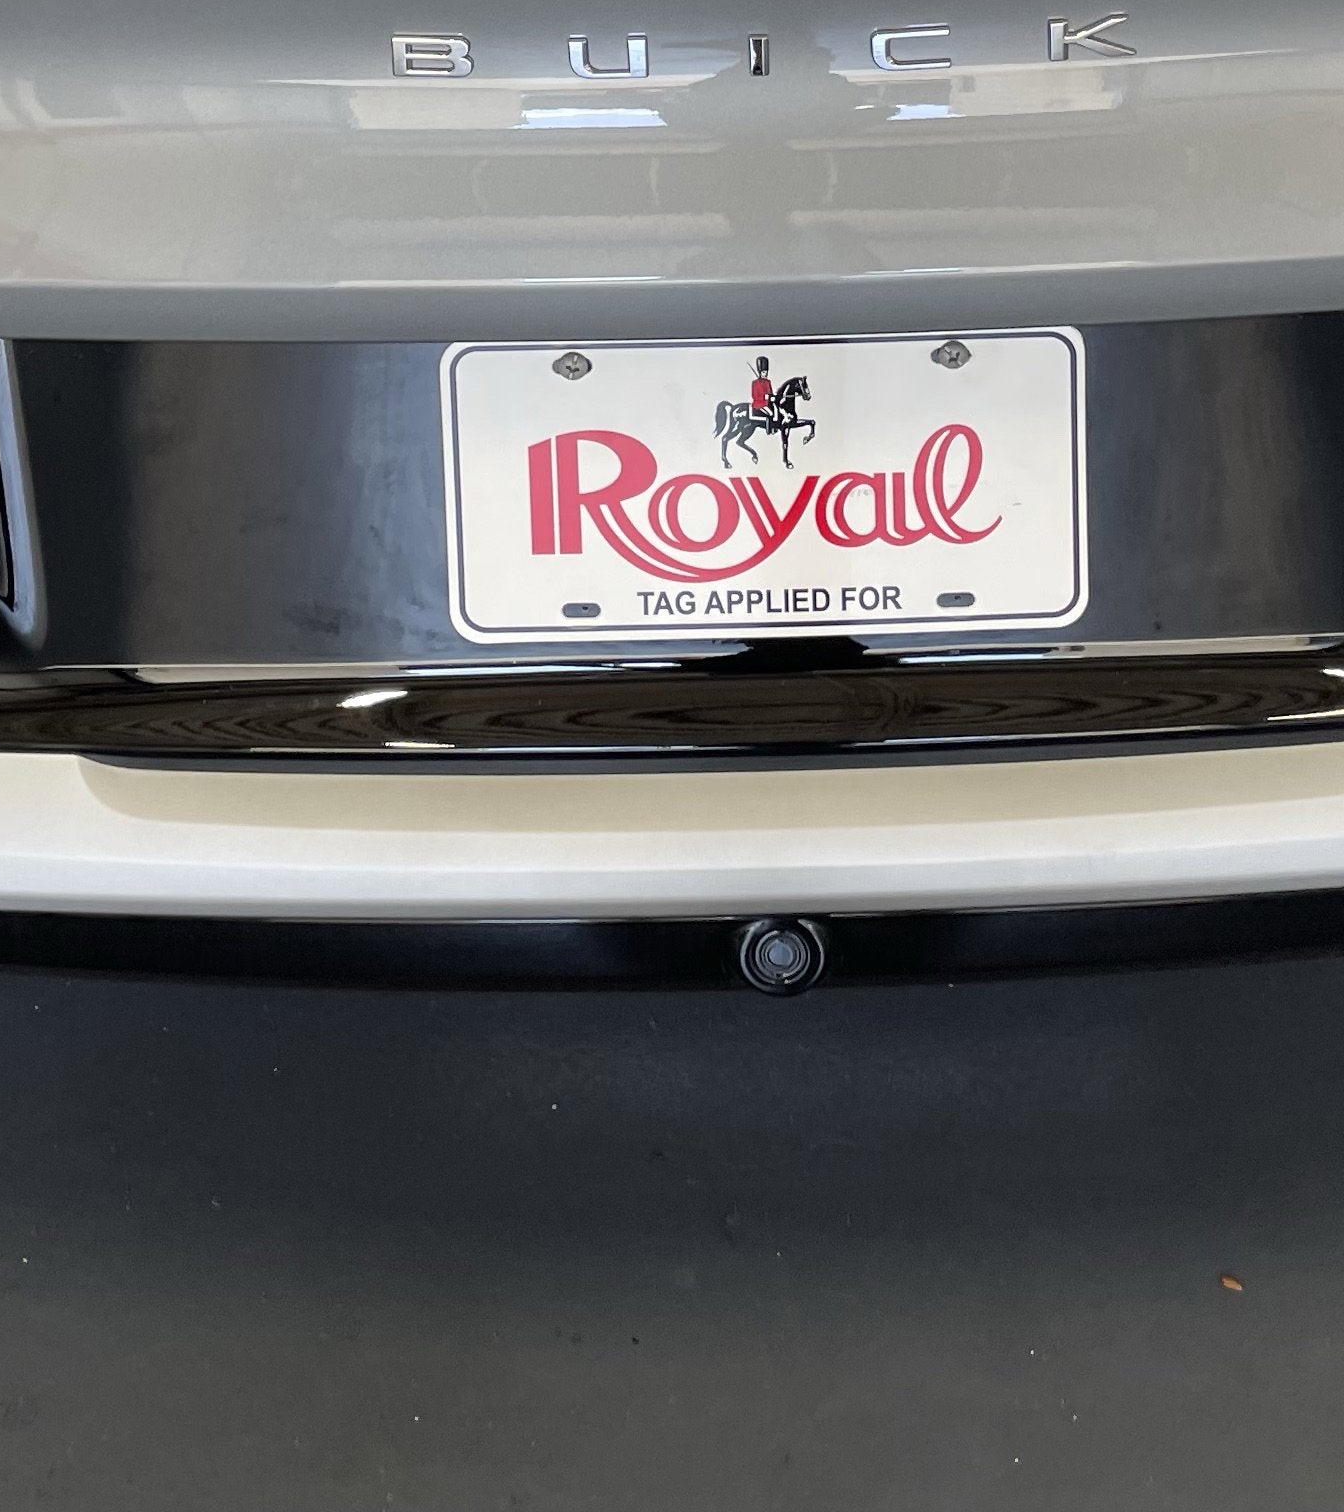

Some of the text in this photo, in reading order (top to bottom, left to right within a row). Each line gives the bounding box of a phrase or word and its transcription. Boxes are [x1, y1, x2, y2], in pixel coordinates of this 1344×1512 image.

[391, 12, 1137, 79] BUICK
[527, 423, 1003, 583] Royal
[636, 585, 903, 617] TAG APPLIED FOR
